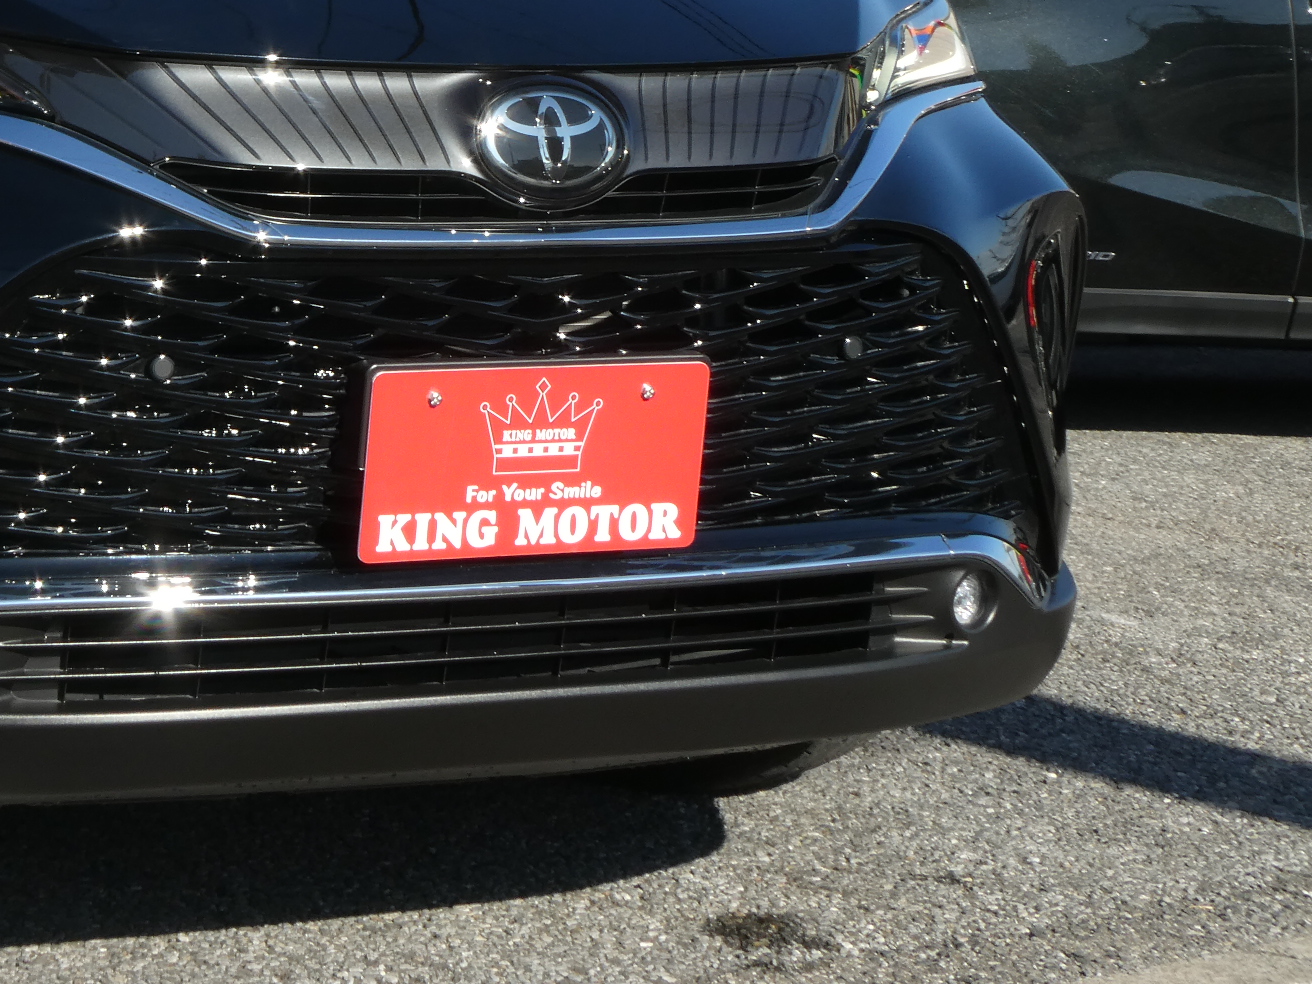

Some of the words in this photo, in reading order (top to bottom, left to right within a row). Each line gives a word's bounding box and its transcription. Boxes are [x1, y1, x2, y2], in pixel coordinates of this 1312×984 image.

[502, 429, 533, 442] KING
[535, 427, 577, 441] MOTOR
[466, 485, 496, 503] For
[502, 483, 545, 502] Your
[549, 481, 602, 500] Smile
[375, 510, 499, 553] KING
[514, 502, 681, 546] MOTOR
